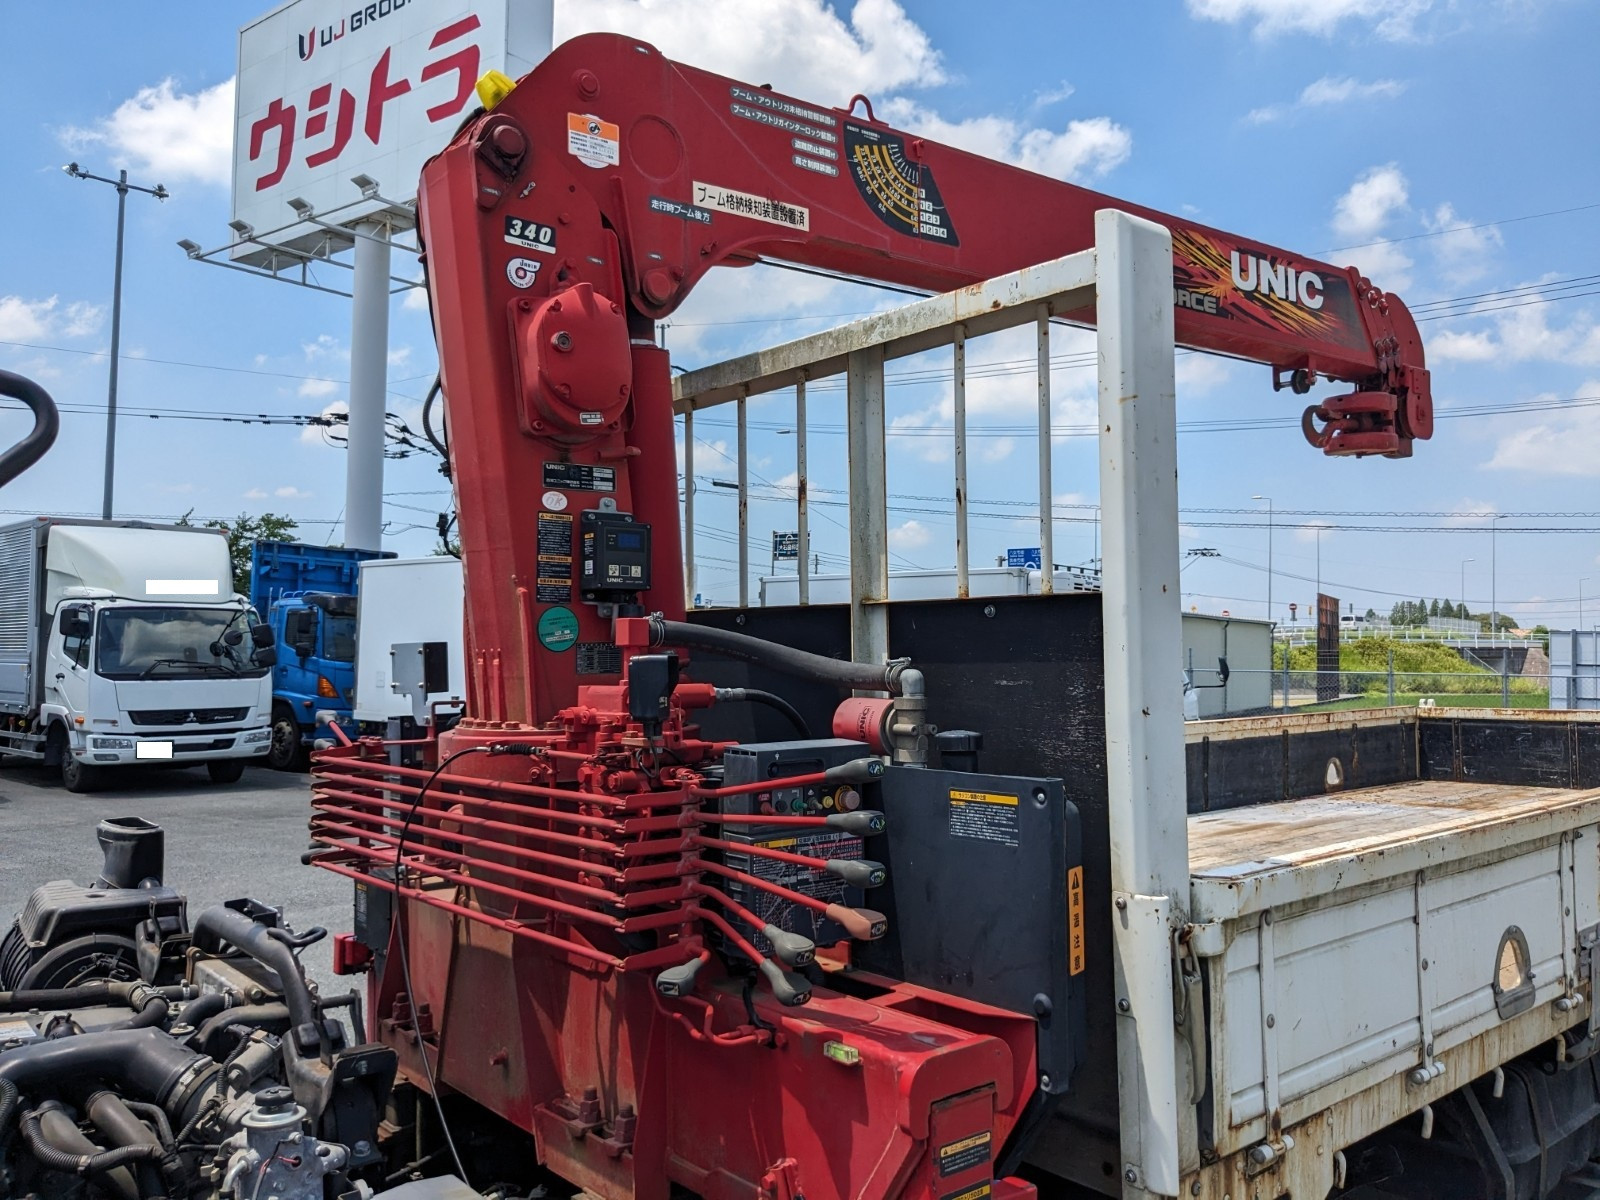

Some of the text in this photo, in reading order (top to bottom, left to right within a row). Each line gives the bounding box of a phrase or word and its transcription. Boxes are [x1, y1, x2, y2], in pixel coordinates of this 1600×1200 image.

[249, 13, 482, 192] ウシトラ
[651, 198, 711, 222] 走行時ブーム後方
[697, 186, 806, 227] ブーム格納検知装置設置済
[509, 219, 552, 244] 340
[521, 240, 540, 249] UNIC
[1230, 250, 1324, 310] UNIC
[859, 706, 871, 739] UNIC
